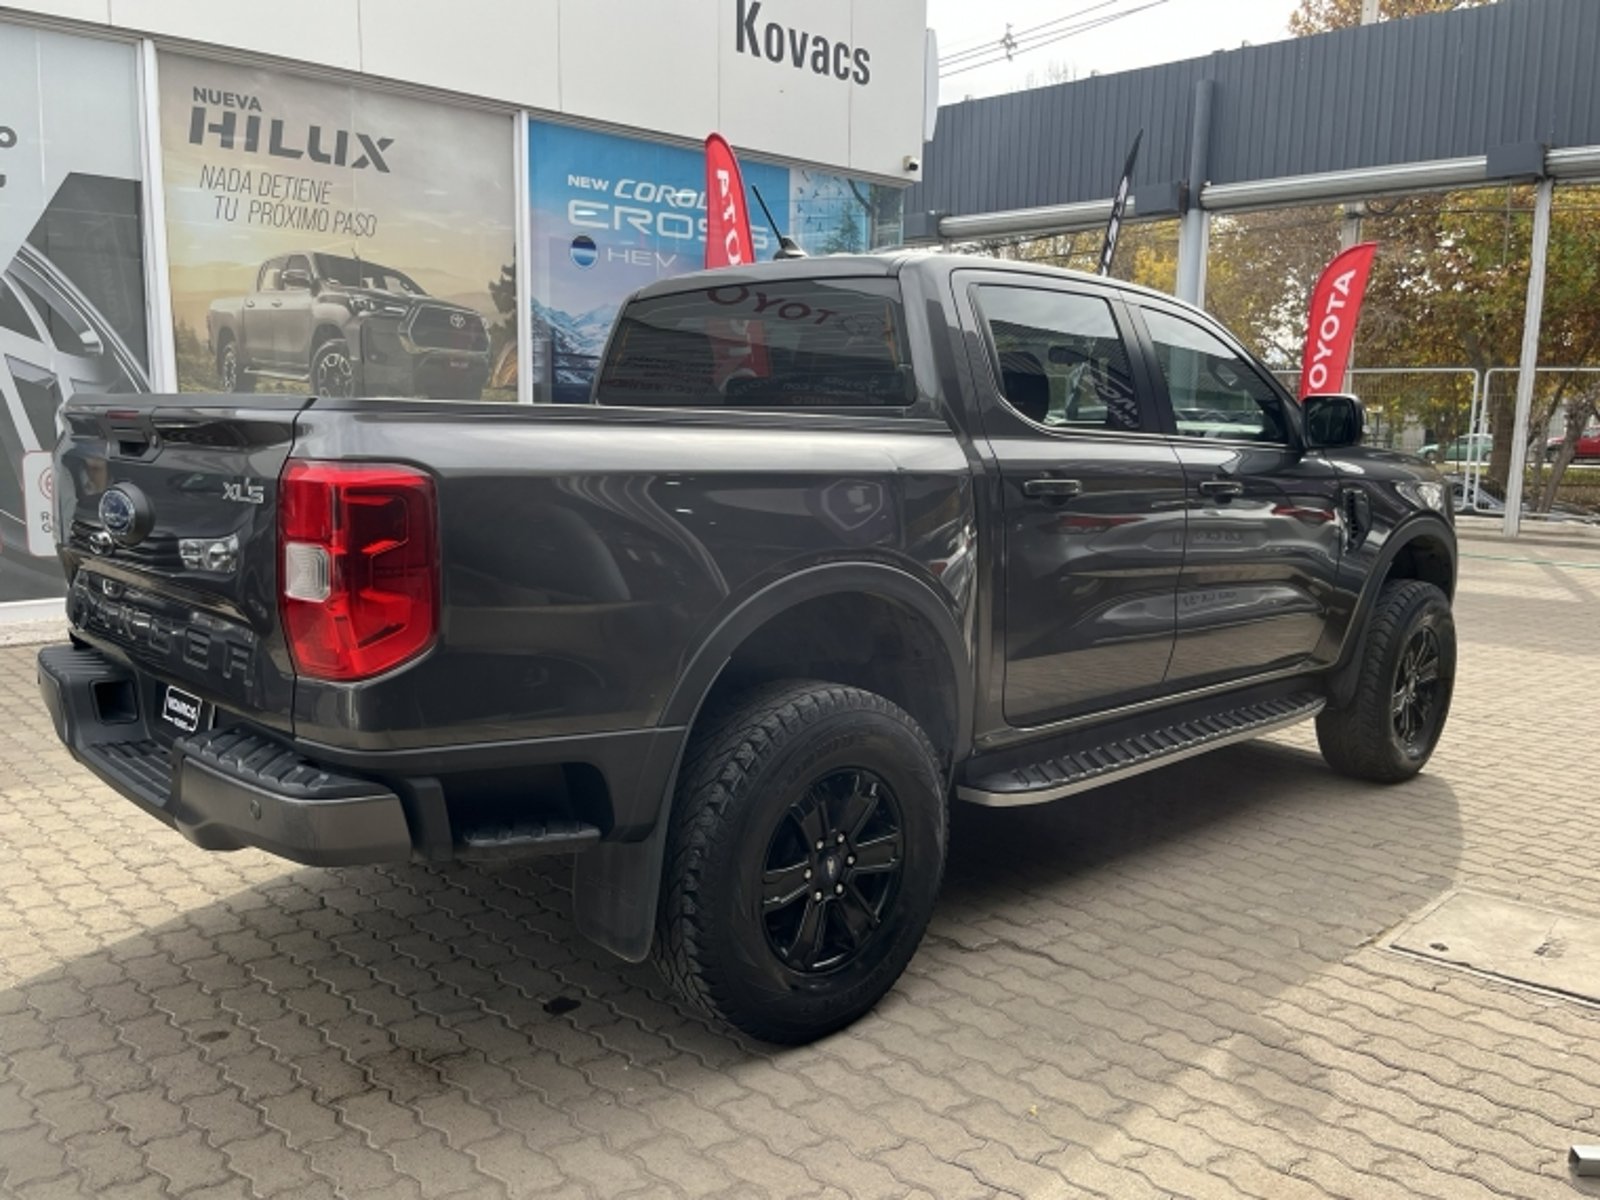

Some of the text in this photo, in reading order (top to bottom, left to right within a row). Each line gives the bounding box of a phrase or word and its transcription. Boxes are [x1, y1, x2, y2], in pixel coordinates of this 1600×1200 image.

[736, 0, 871, 86] Kovacs
[192, 86, 262, 112] NUEVA
[189, 106, 394, 173] HILUX
[200, 164, 333, 205] NADA DETIENE
[567, 174, 708, 210] NEW COROL
[214, 195, 377, 238] TU PRÓXIMO PASO
[608, 247, 677, 268] HEV
[1307, 269, 1356, 392] OYOTA
[222, 481, 264, 504] XLS
